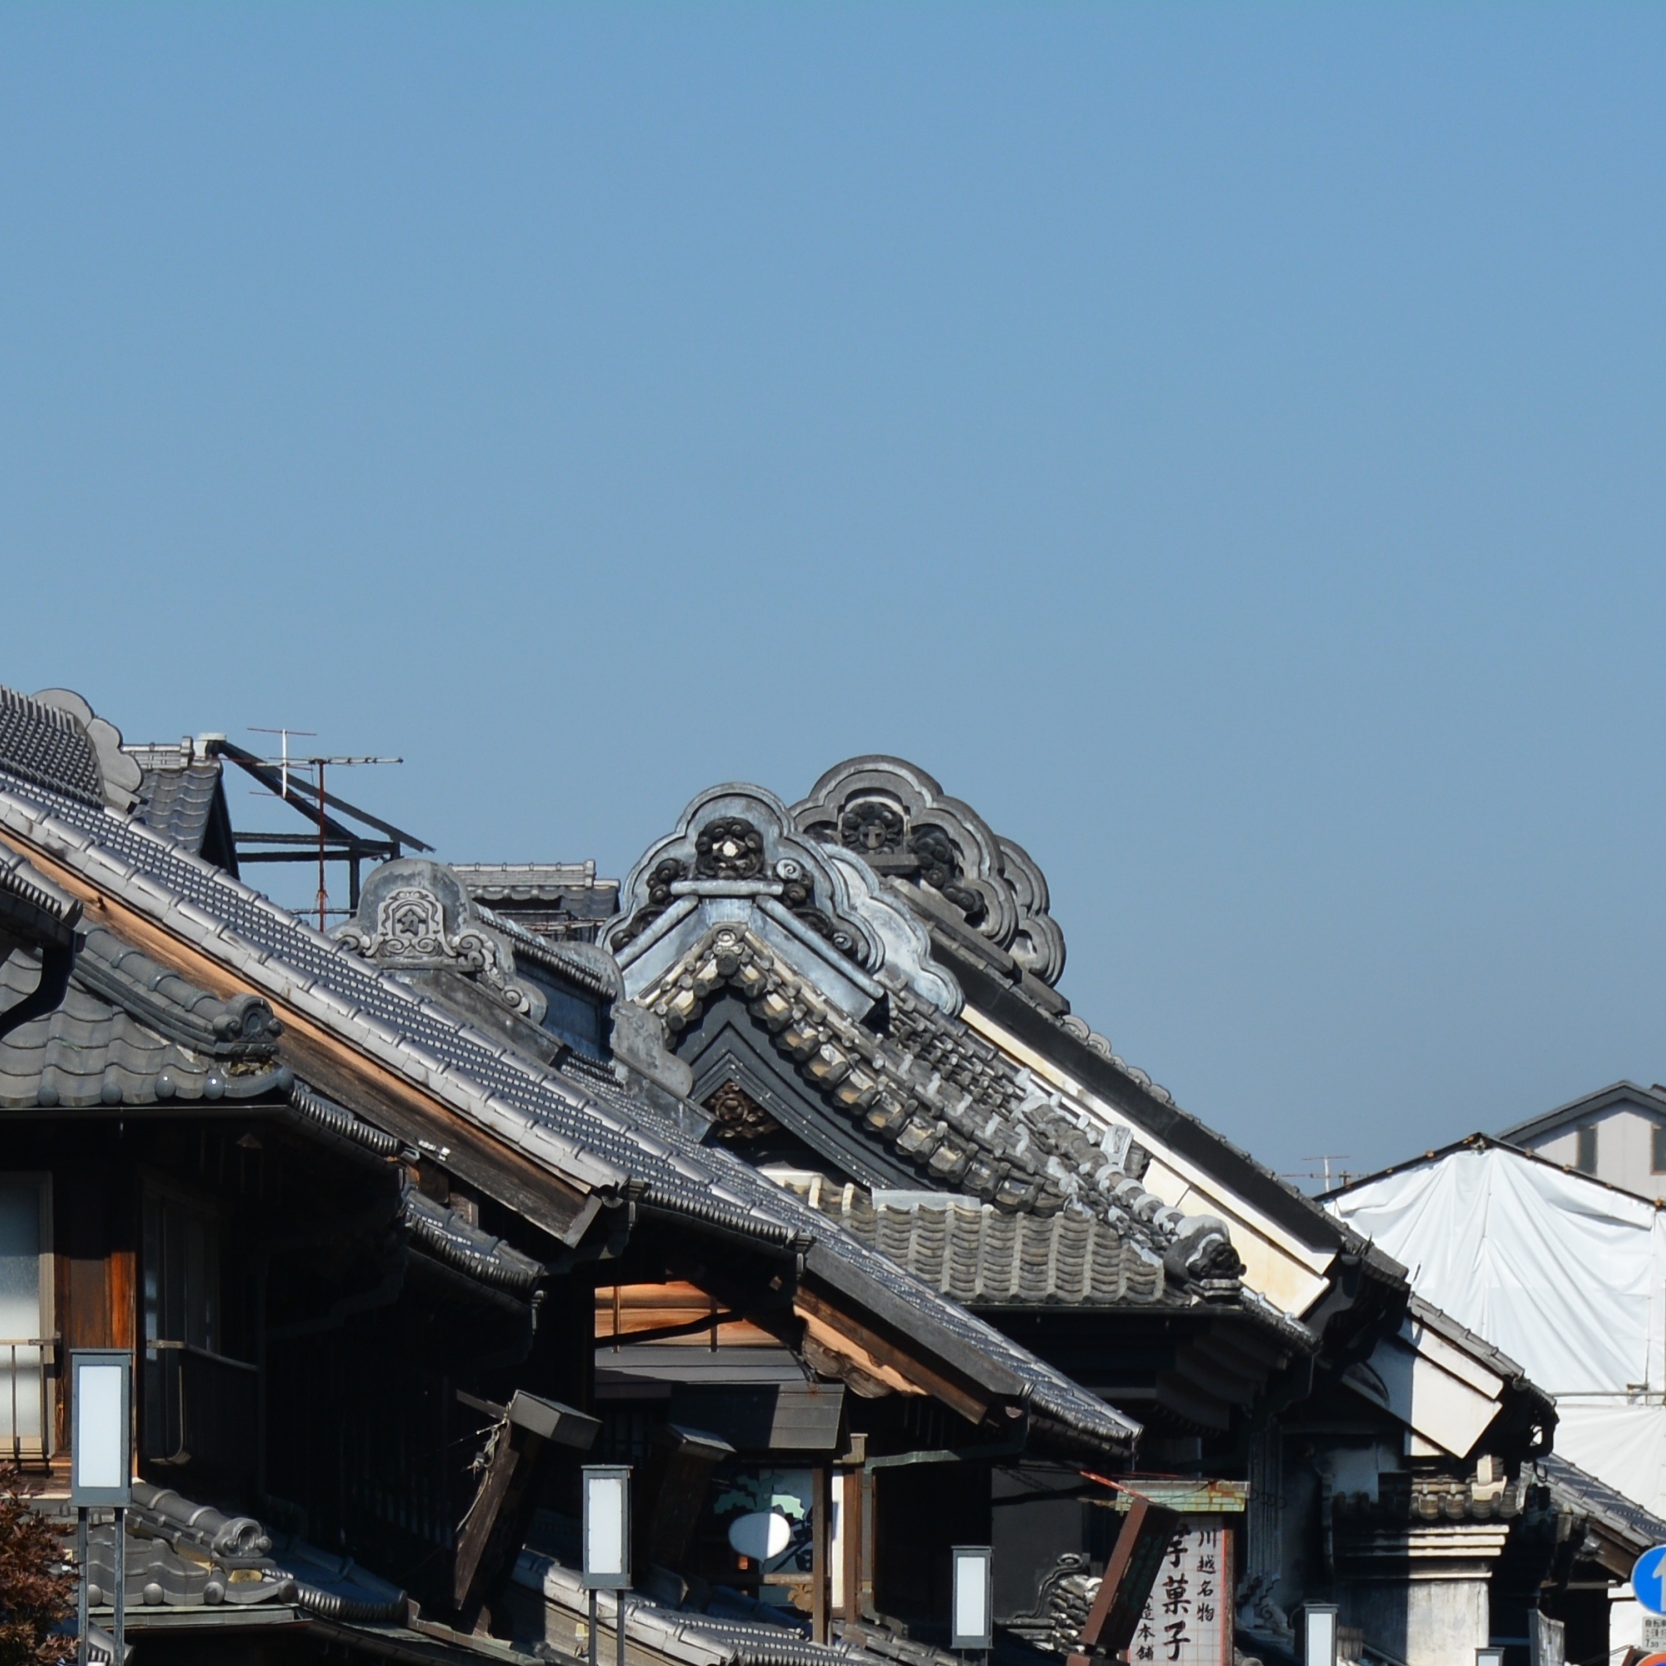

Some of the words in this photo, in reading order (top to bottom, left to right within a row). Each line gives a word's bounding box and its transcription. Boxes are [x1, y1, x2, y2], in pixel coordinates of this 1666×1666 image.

[1162, 1524, 1191, 1662] 芋菓子
[1196, 1528, 1217, 1622] 川越名物
[1136, 1594, 1156, 1661] 造本舗
